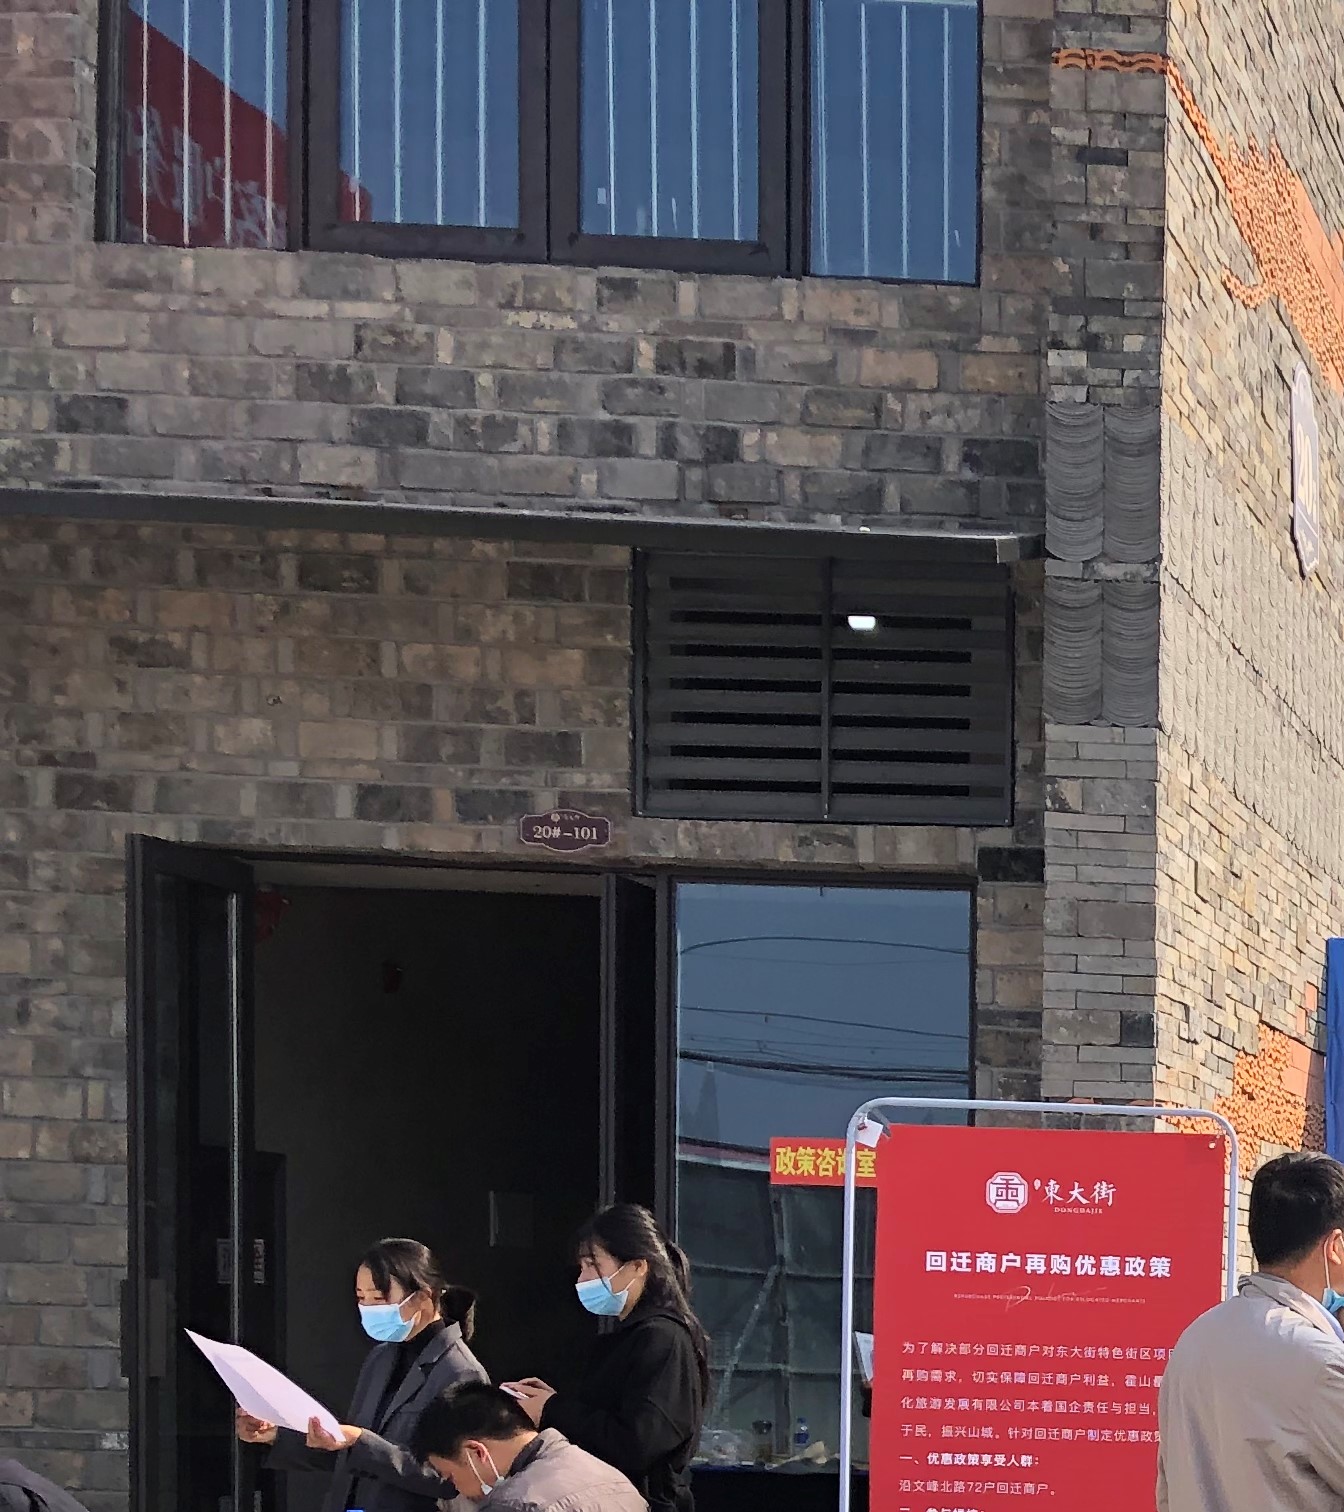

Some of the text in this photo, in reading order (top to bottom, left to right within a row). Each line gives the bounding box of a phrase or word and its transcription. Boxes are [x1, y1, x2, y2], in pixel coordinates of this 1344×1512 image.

[924, 1250, 1172, 1279] 回迁商户再购优惠政策
